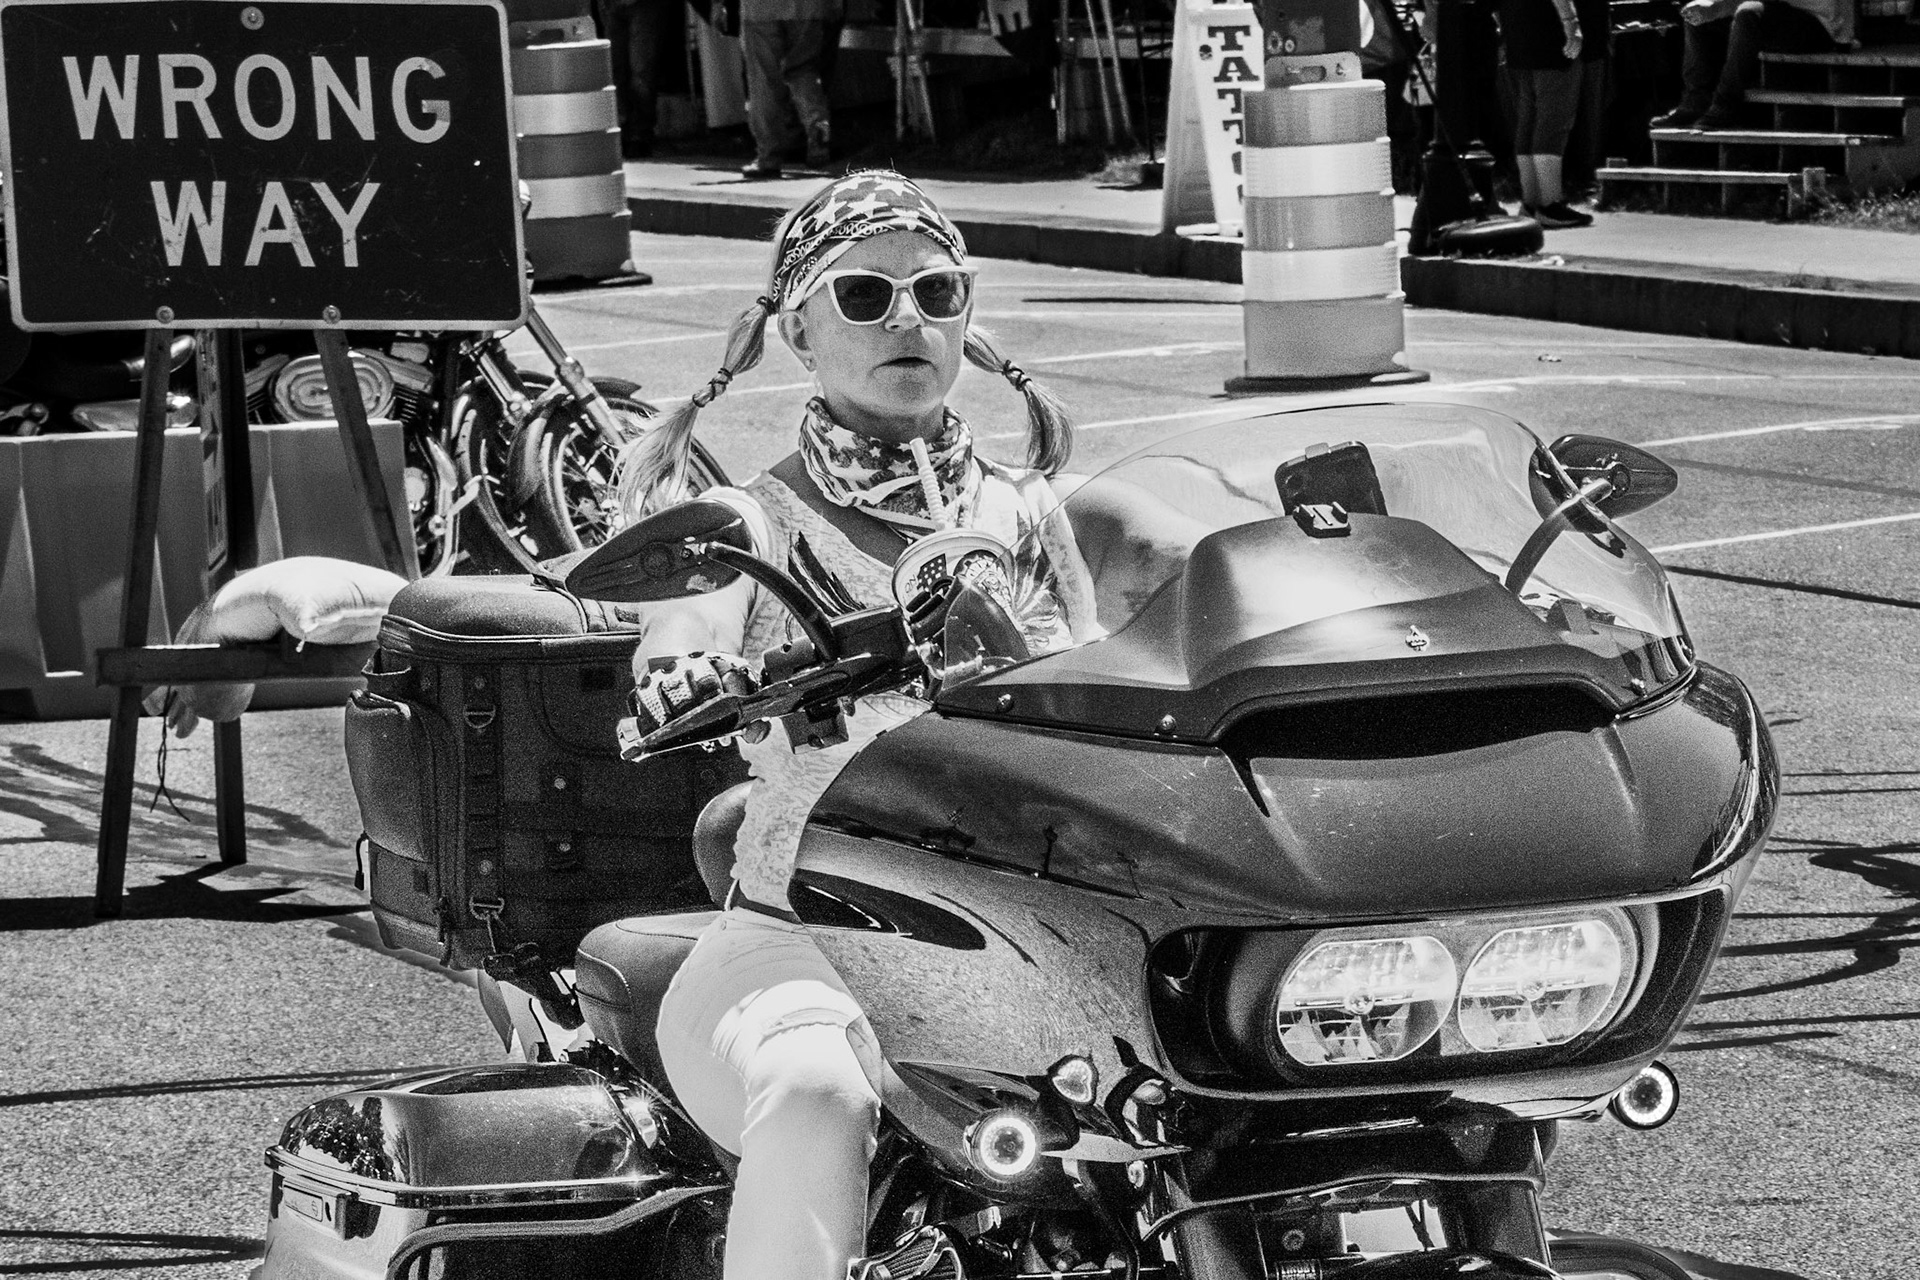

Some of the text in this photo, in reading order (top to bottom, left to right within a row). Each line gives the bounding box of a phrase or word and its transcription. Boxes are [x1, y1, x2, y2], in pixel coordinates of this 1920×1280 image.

[63, 54, 449, 143] WRONG
[1208, 25, 1259, 202] TATT
[151, 181, 379, 266] WAY
